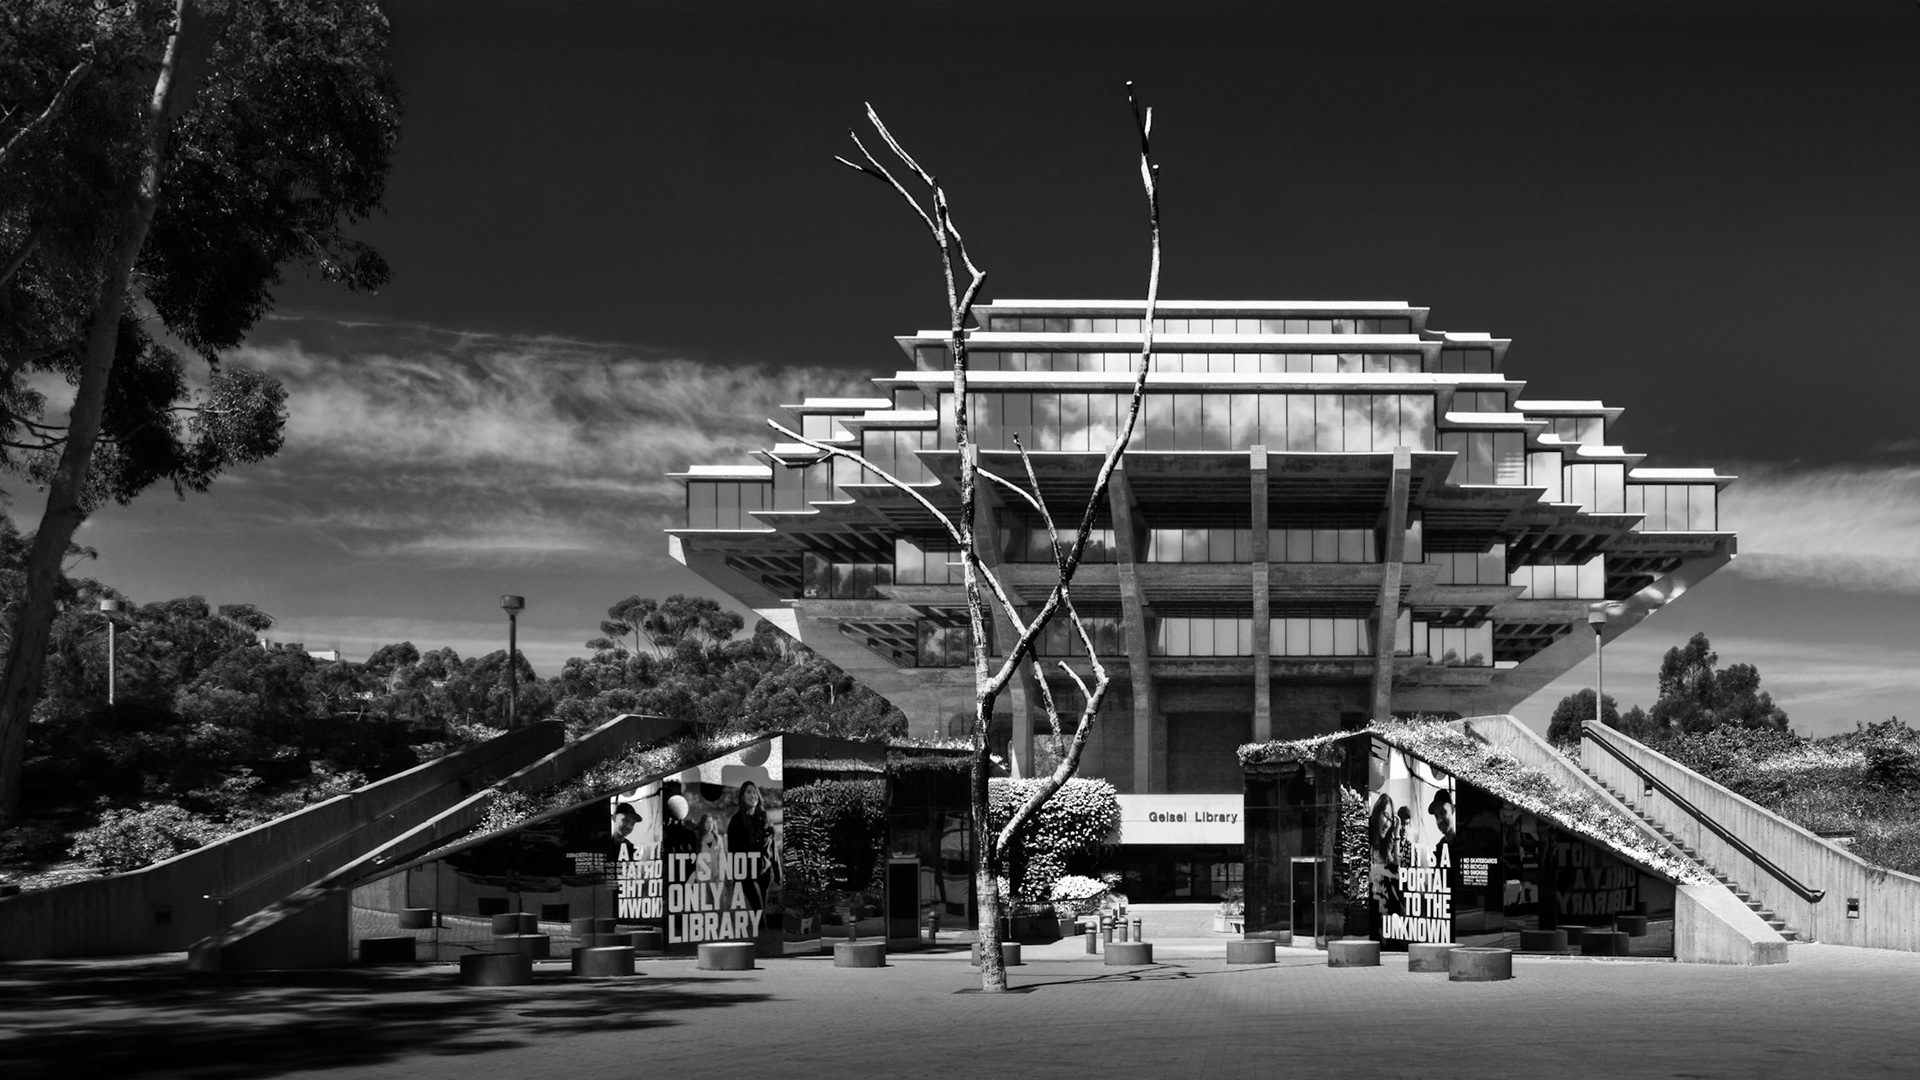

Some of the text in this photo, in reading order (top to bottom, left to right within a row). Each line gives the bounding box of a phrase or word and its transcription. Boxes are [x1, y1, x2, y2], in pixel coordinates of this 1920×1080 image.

[1149, 811, 1238, 824] Geisel Library
[668, 852, 761, 882] IT'S NOT
[1440, 843, 1451, 868] A
[1399, 867, 1451, 893] PORTAL
[668, 882, 746, 913] ONLY A
[1403, 892, 1451, 919] TO THE
[668, 910, 763, 944] LIBRARY
[1383, 913, 1451, 944] UNKNOWN
